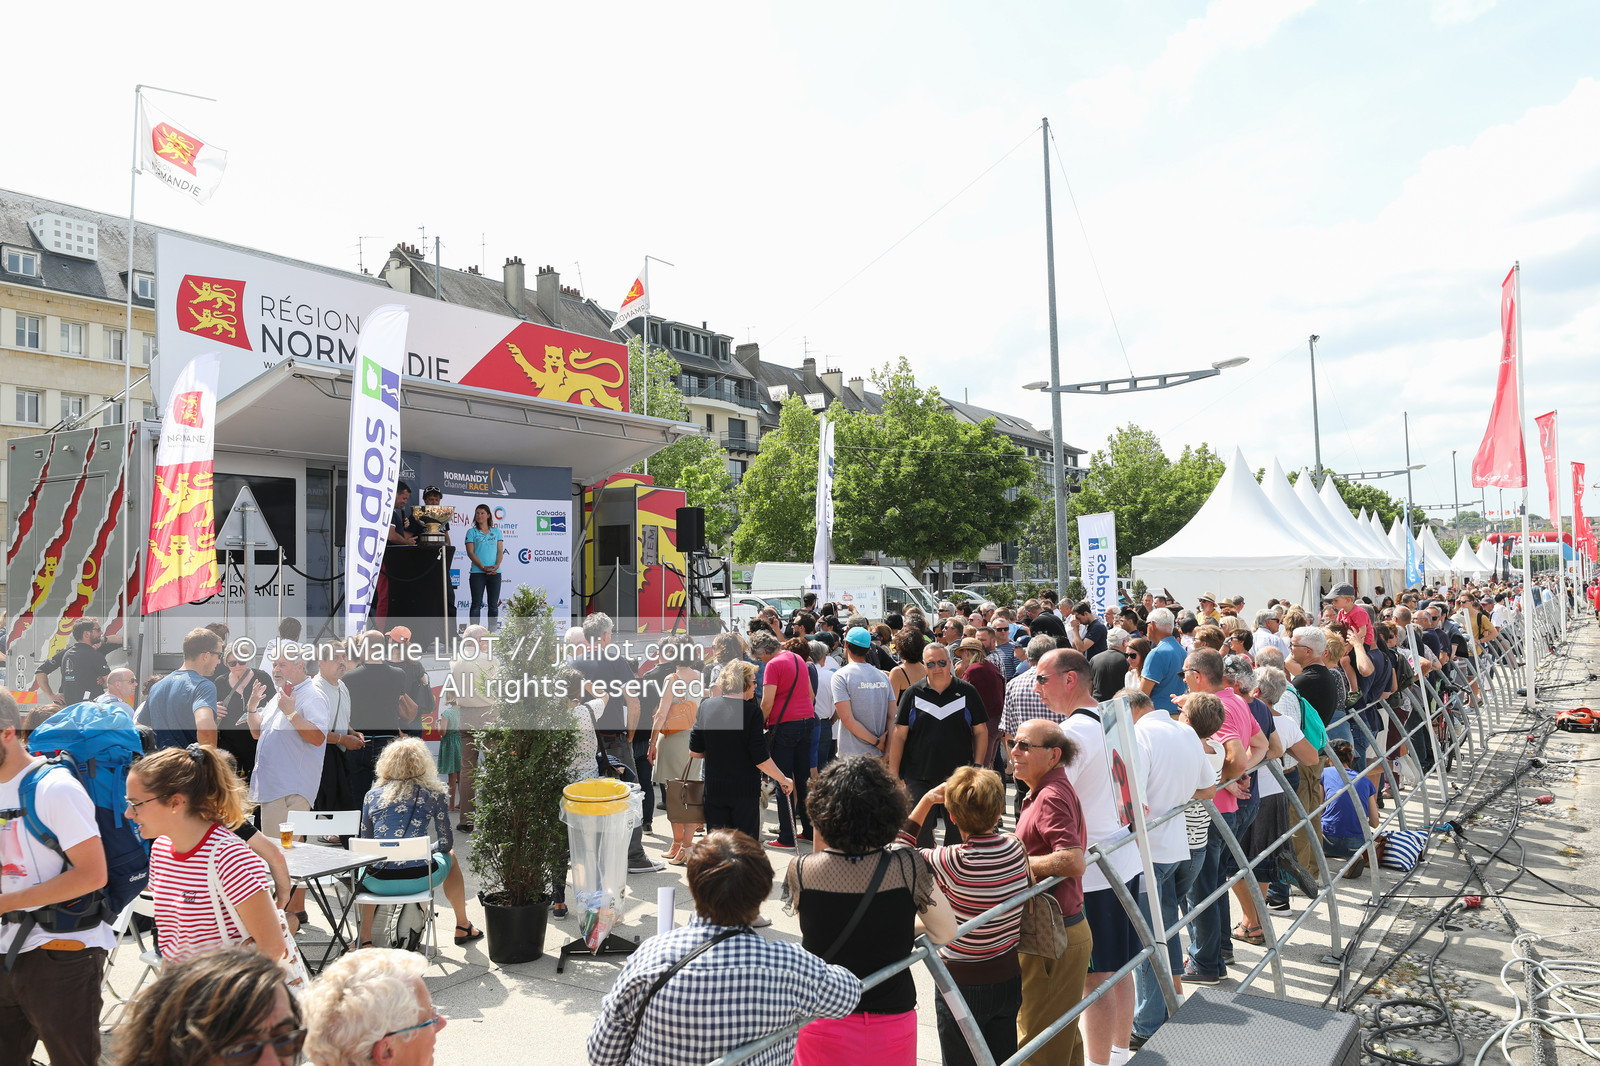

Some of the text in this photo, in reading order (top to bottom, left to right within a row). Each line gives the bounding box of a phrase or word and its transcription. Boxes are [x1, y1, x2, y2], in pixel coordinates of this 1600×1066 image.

[260, 295, 360, 334] RÉGION
[261, 323, 451, 383] NORMDIE
[443, 471, 488, 482] NORMANDY
[443, 480, 489, 491] Channel RACE
[348, 416, 386, 632] lvados
